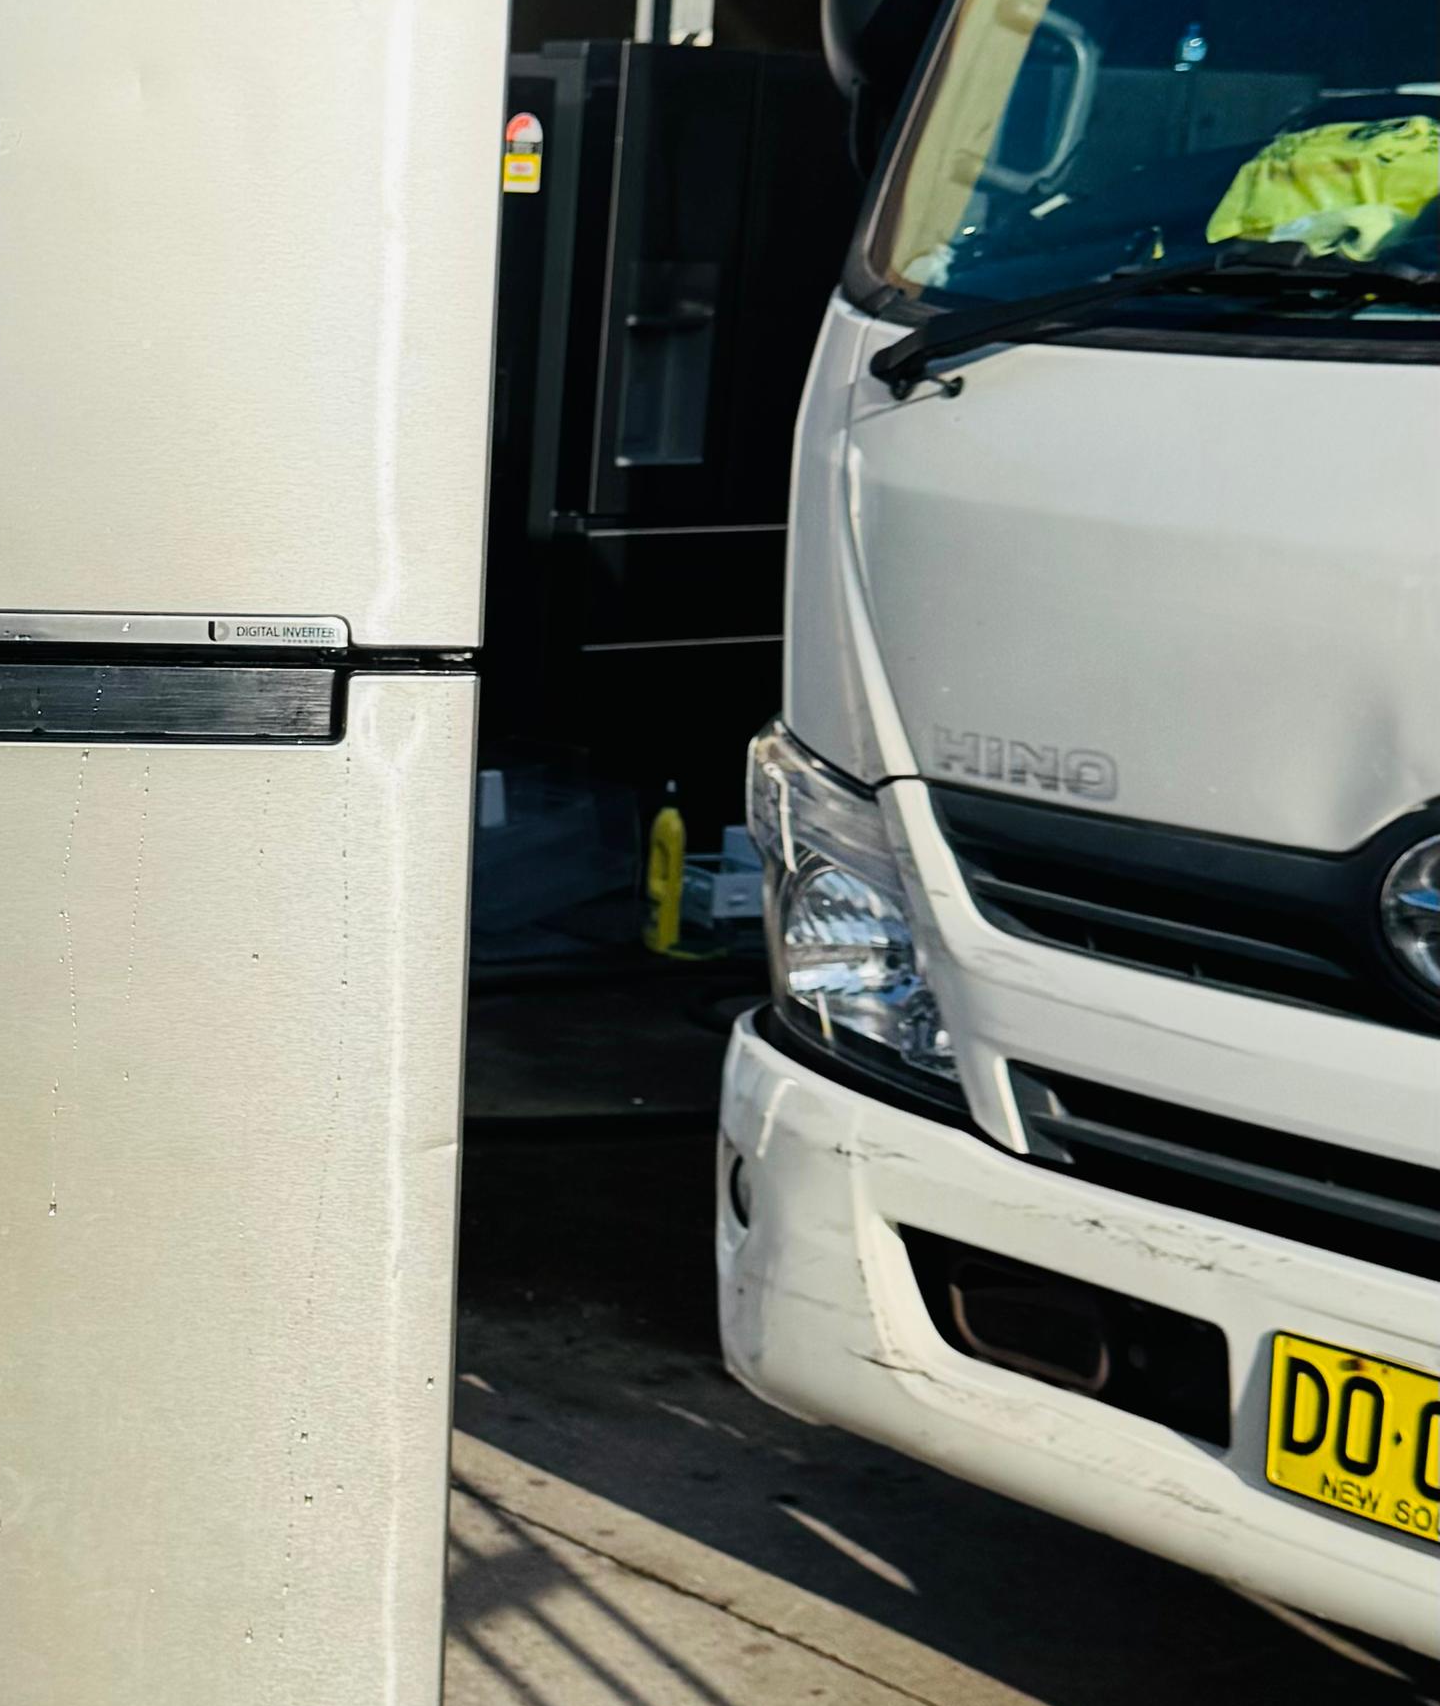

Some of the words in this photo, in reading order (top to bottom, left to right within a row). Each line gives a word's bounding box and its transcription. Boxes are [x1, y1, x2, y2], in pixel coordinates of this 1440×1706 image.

[236, 625, 280, 638] DIGITAL
[282, 626, 336, 638] INVERTER
[933, 724, 1118, 801] HINO
[1320, 1473, 1382, 1513] NEW
[1394, 1499, 1440, 1536] SO
